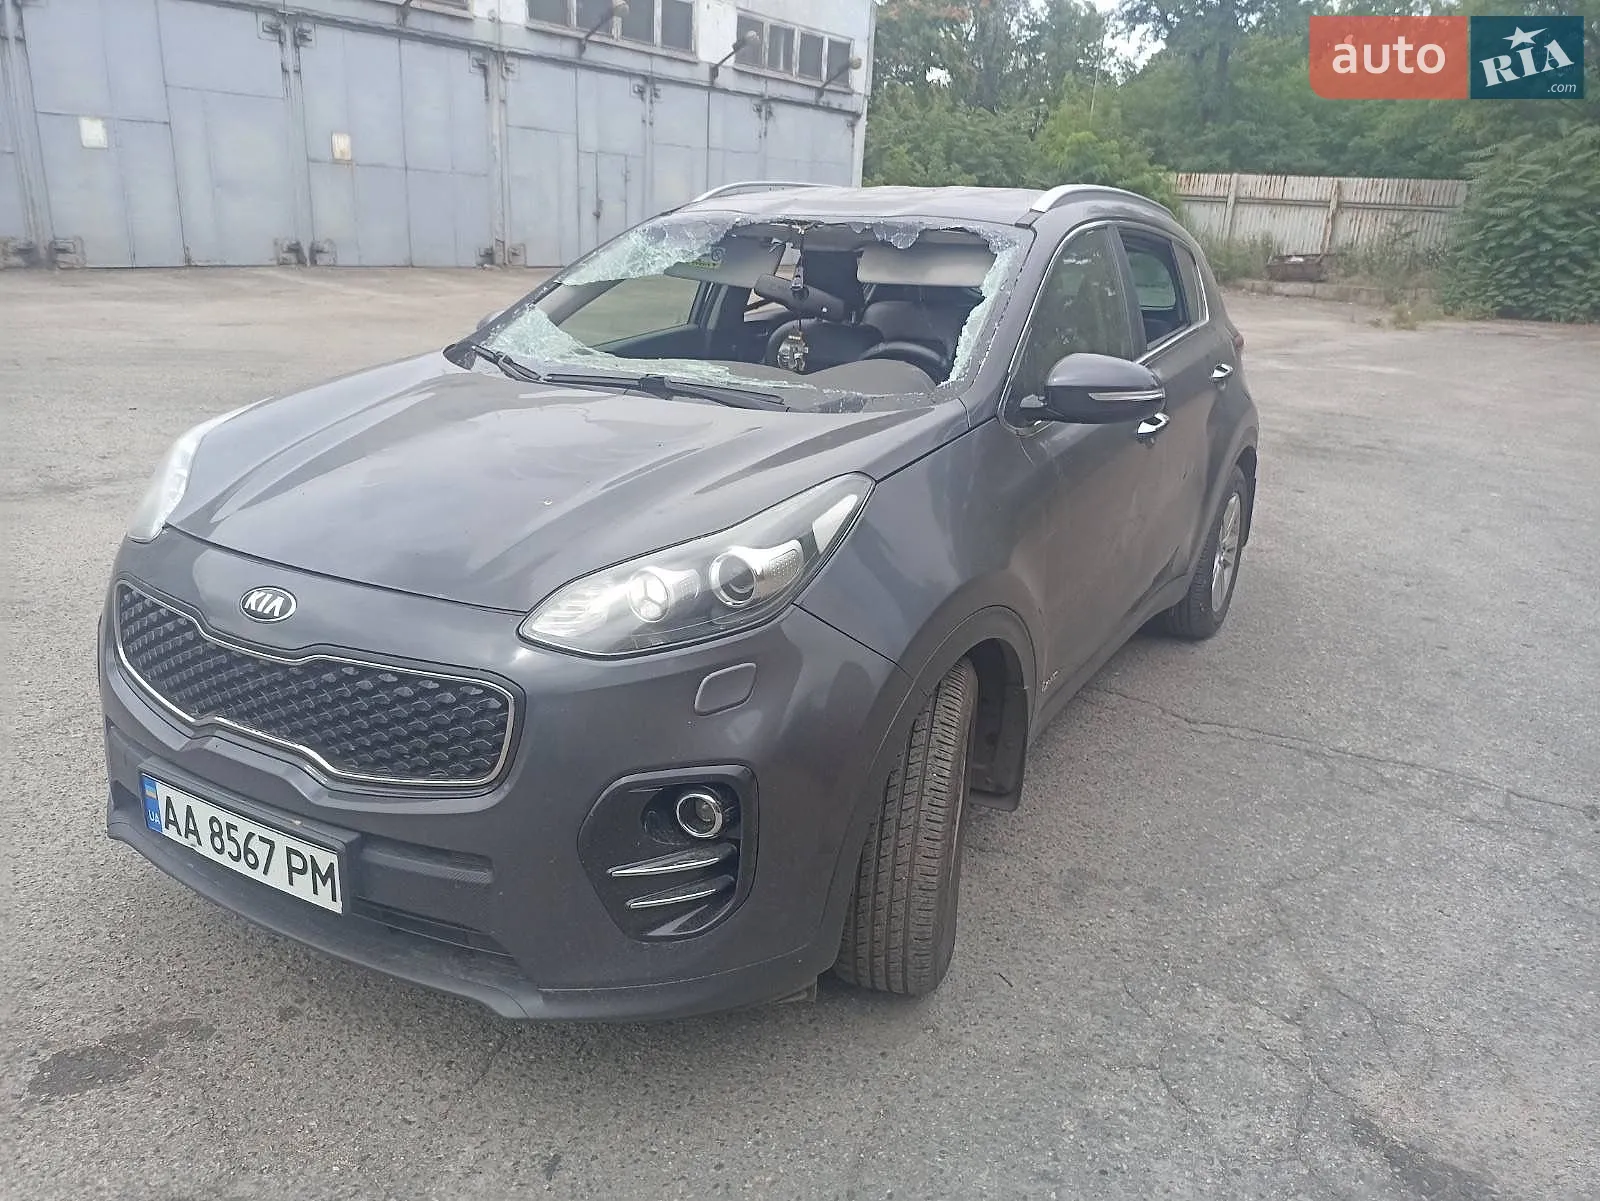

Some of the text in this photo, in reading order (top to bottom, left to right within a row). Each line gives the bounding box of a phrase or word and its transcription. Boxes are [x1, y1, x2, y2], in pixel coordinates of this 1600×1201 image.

[244, 590, 285, 617] KIA
[148, 809, 161, 825] UA
[164, 796, 337, 903] AA 8567 PM
